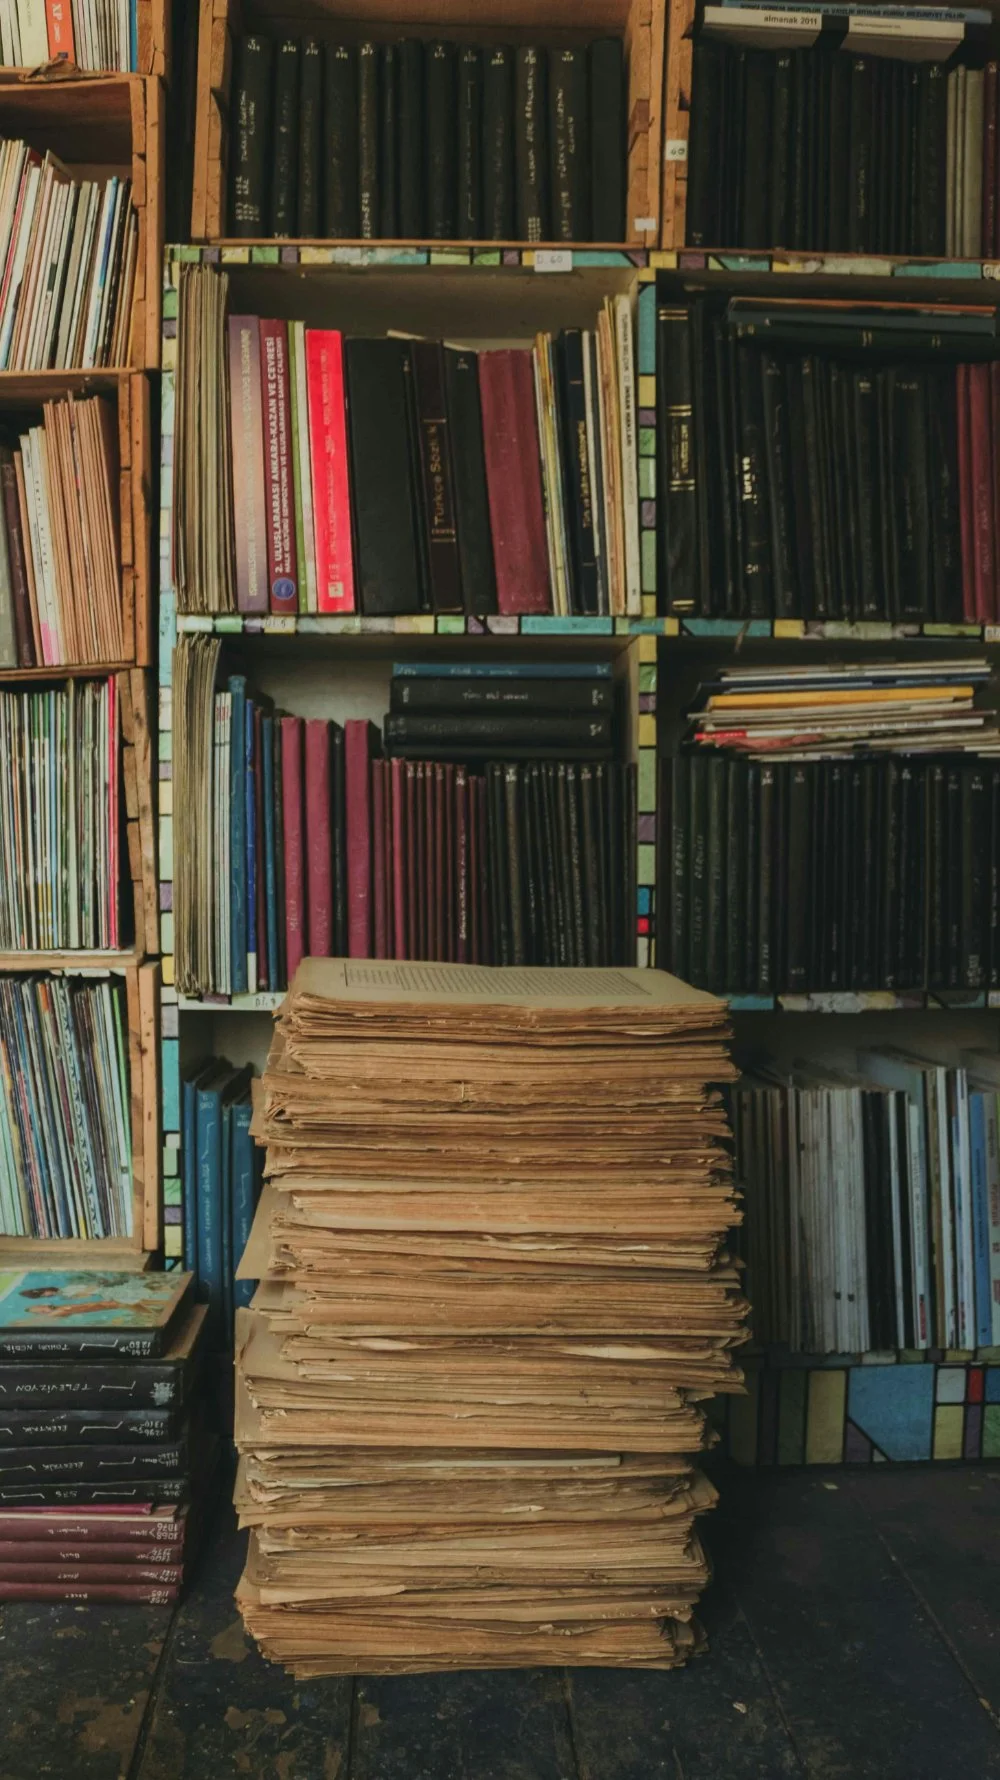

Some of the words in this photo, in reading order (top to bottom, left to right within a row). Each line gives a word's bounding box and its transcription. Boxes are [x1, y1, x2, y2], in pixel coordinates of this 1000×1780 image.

[764, 16, 798, 24] almanak
[800, 17, 817, 25] 2011
[267, 381, 276, 396] VE
[268, 399, 280, 481] ANKARA-KAZAN
[280, 455, 287, 466] VE
[271, 483, 282, 561] ULUSLARARASI
[275, 563, 283, 573] 2.
[15, 1383, 89, 1392] TELEVİZYON
